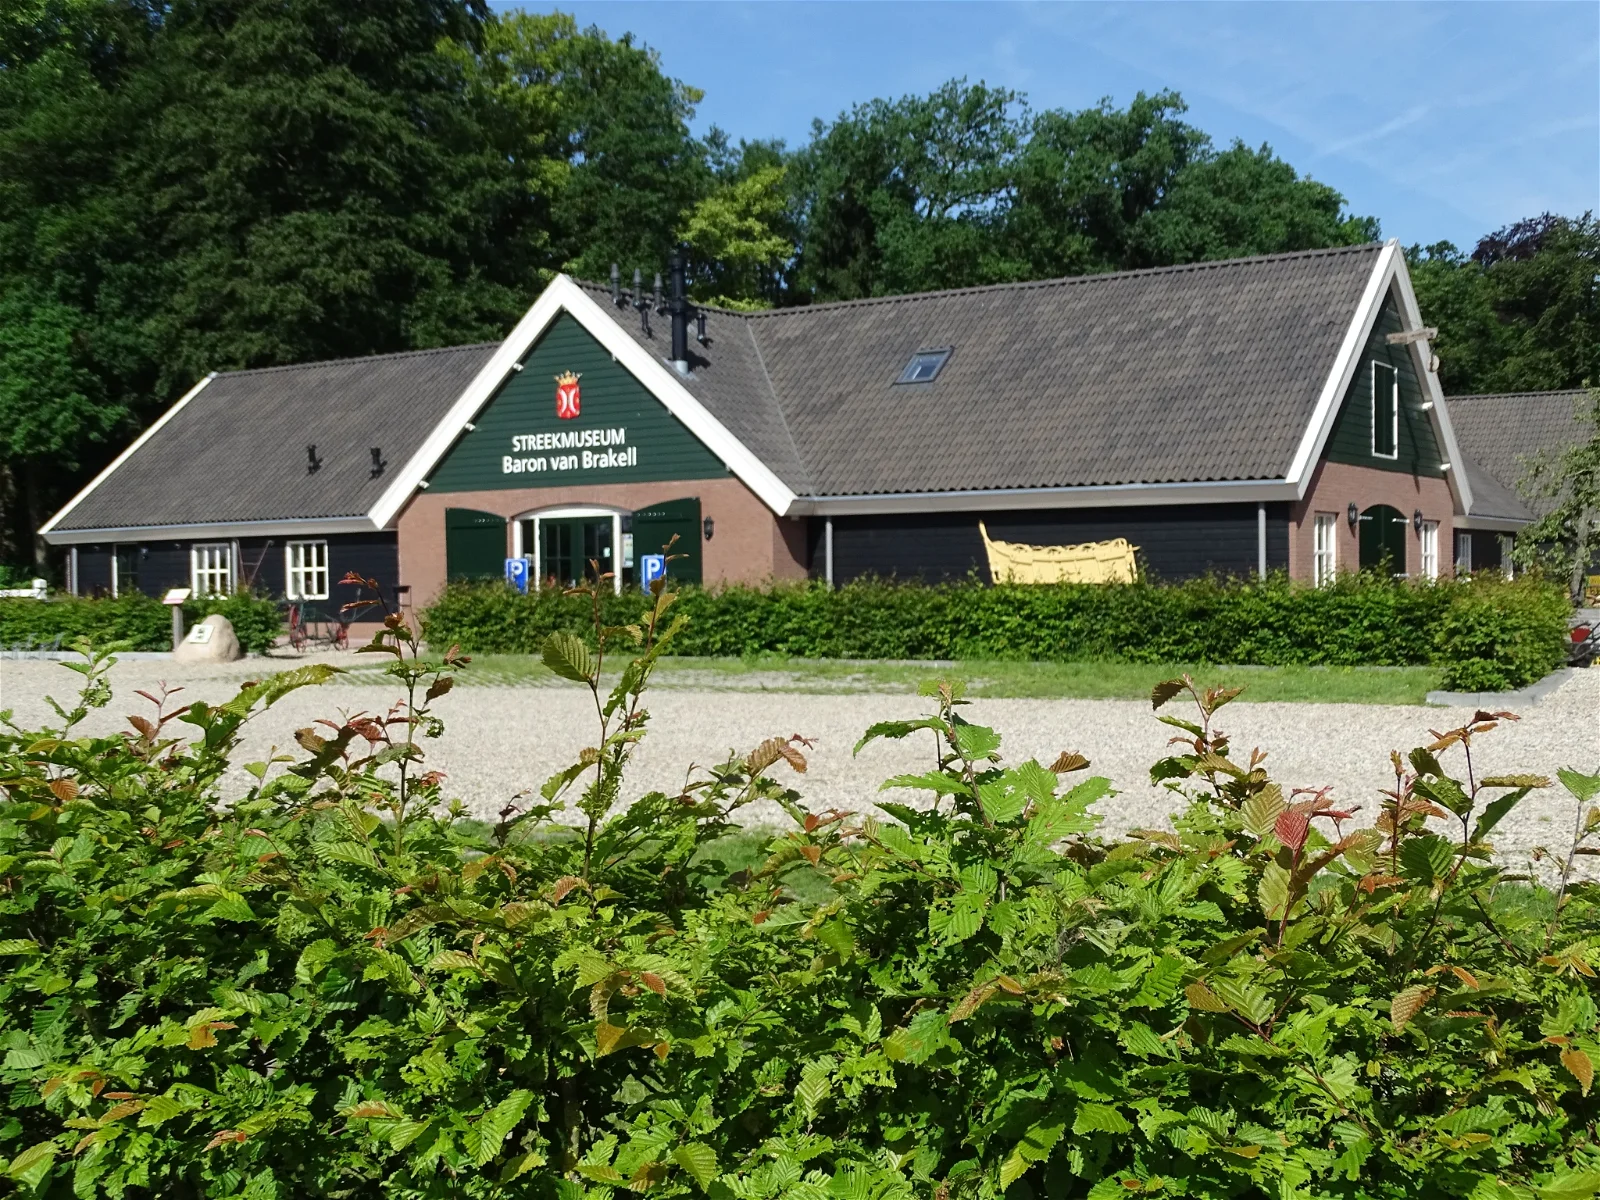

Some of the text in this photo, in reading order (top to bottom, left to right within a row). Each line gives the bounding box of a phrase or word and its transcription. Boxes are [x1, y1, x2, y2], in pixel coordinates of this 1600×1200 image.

[512, 428, 625, 452] STREEKMUSEUM
[502, 446, 637, 474] Baron van Brakell
[511, 561, 523, 578] P
[648, 558, 661, 579] P
